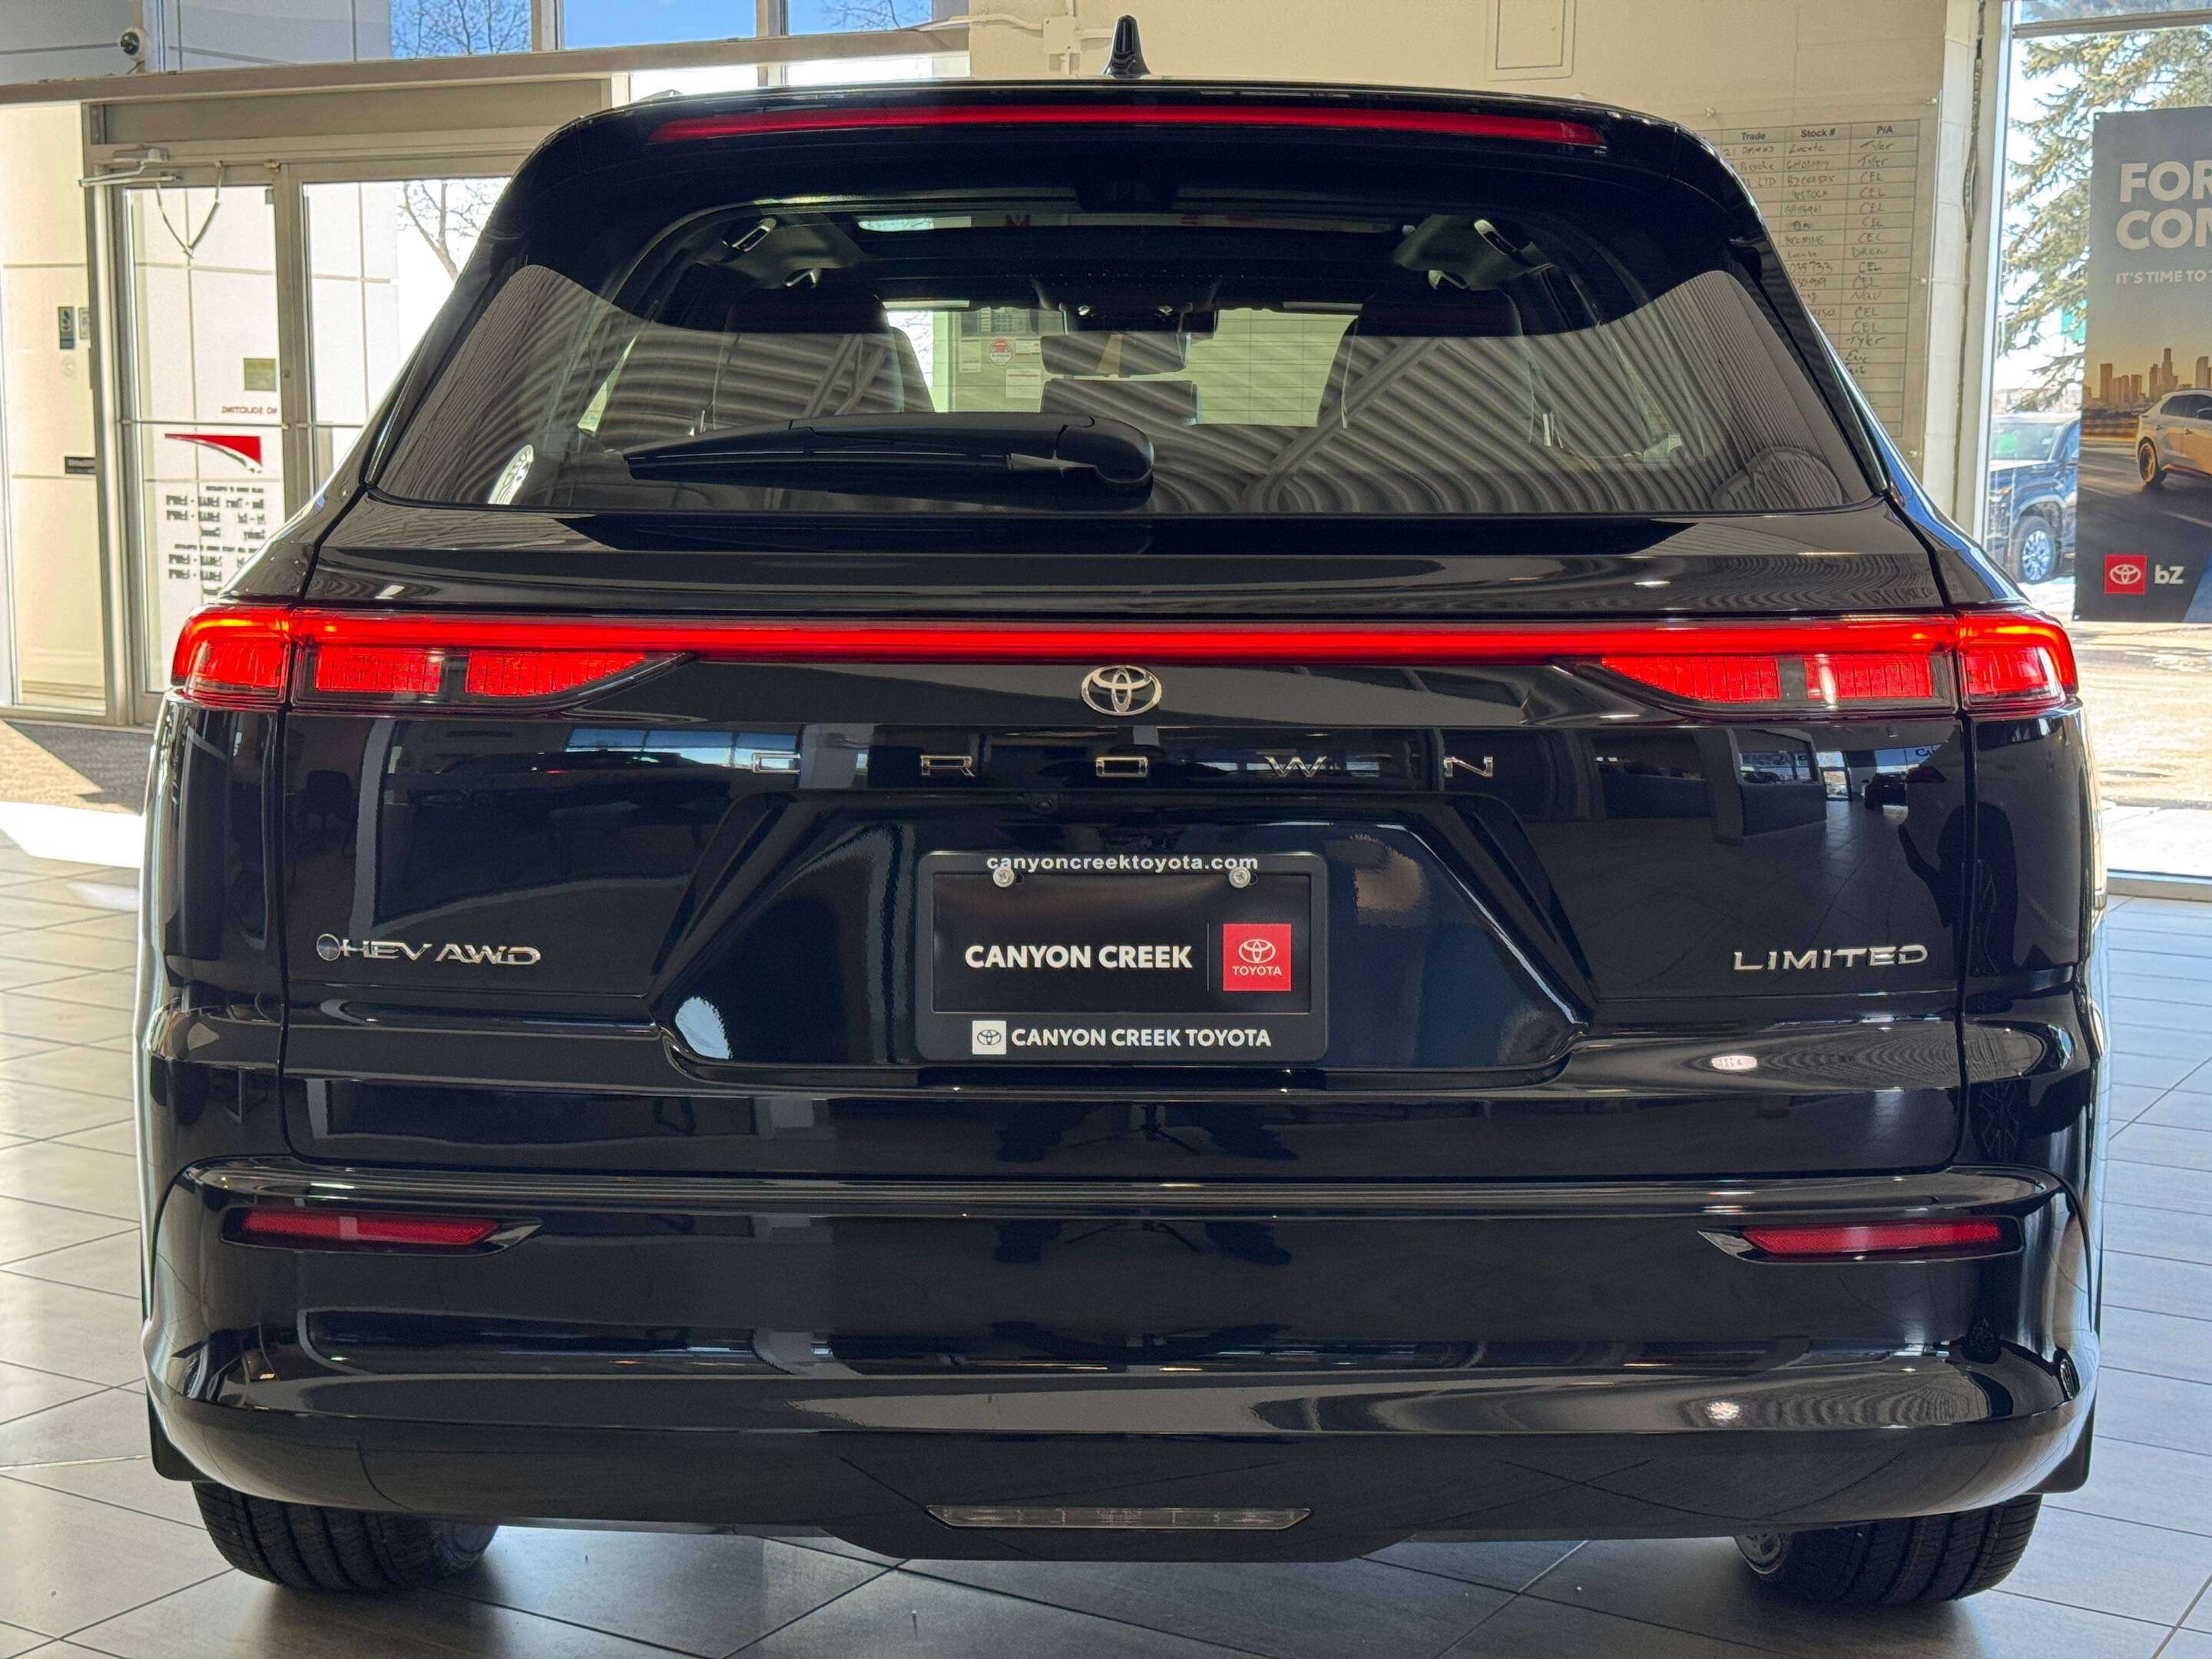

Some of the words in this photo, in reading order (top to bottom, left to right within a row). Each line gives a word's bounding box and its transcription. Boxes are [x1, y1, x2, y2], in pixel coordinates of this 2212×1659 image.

[1741, 132, 1767, 141] Trade
[1801, 129, 1829, 138] Stock
[2116, 271, 2143, 284] IT'S
[2145, 270, 2183, 283] TIME
[2186, 270, 2207, 283] TO
[2154, 565, 2184, 584] bZ
[751, 751, 1495, 778] CROWN
[986, 855, 1258, 874] canyoncreektoyota.com
[435, 943, 541, 965] AWD
[965, 945, 1091, 969] CANYON
[1098, 945, 1193, 969] CREEK
[1734, 944, 1929, 971] LIMITED
[1232, 965, 1283, 977] TOYOTA
[1011, 1028, 1107, 1048] CANYON
[1111, 1028, 1181, 1048] CREEK
[1184, 1028, 1272, 1048] TOYOTA
